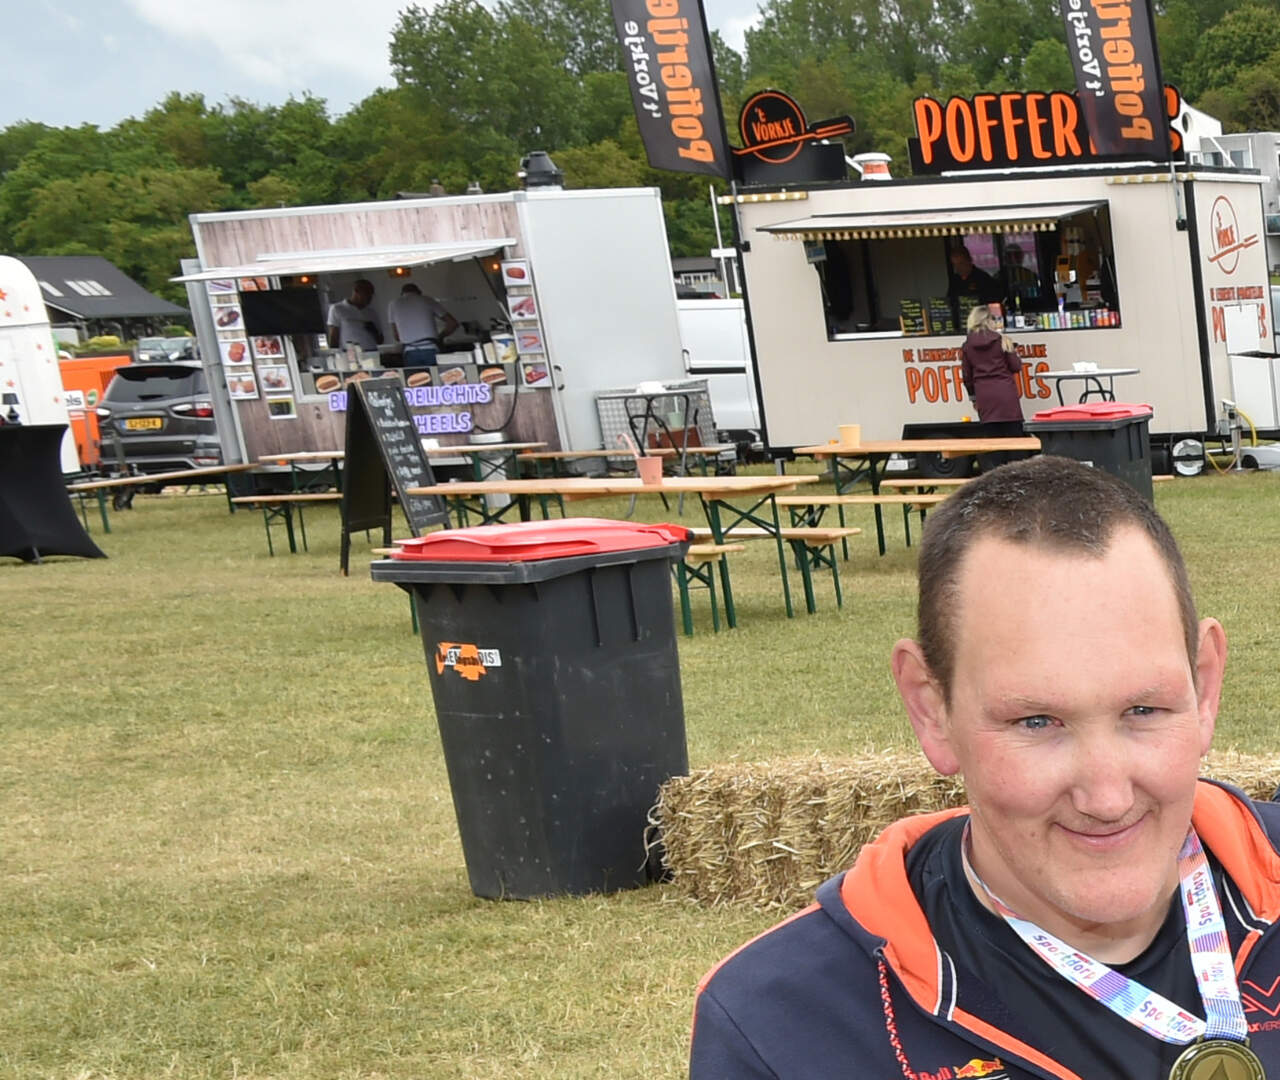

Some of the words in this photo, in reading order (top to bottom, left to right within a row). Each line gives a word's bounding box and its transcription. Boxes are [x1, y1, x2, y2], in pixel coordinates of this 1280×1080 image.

[752, 119, 797, 142] VORKJE
[914, 86, 1181, 165] POFFER
[404, 383, 490, 406] DELIGHTS
[413, 412, 472, 433] HEELS
[1033, 934, 1096, 981] Sportdorp
